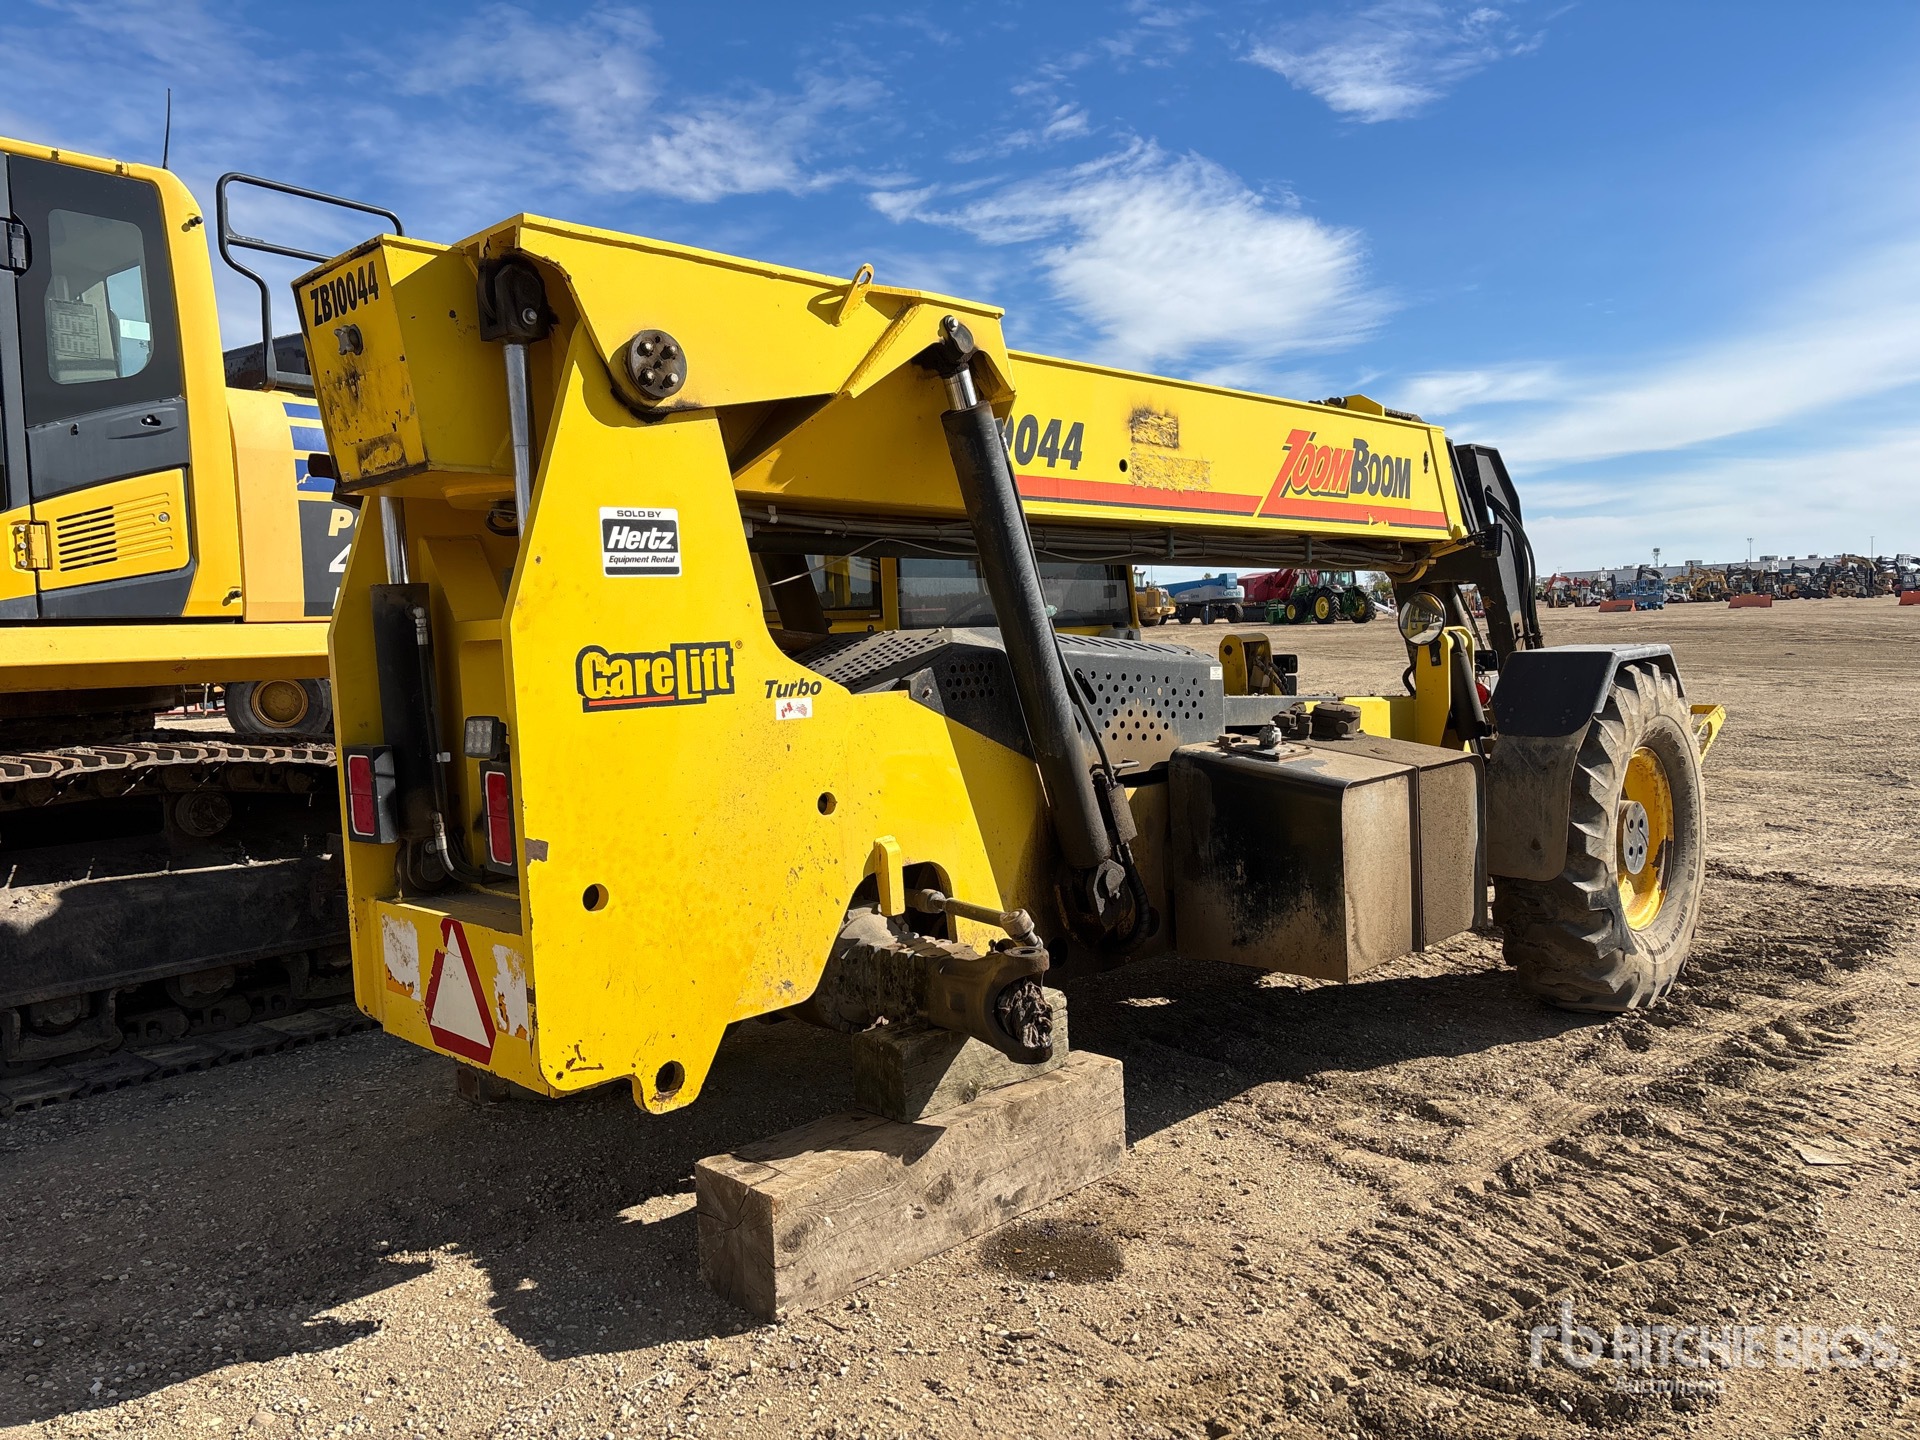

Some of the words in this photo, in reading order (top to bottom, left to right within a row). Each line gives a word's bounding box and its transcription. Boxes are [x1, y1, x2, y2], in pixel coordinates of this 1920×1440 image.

[310, 261, 379, 326] ZB10044
[616, 510, 646, 518] SOLD
[607, 526, 675, 549] Hertz
[609, 555, 649, 565] Equipment
[650, 555, 676, 563] Rental
[764, 678, 822, 698] Turbo
